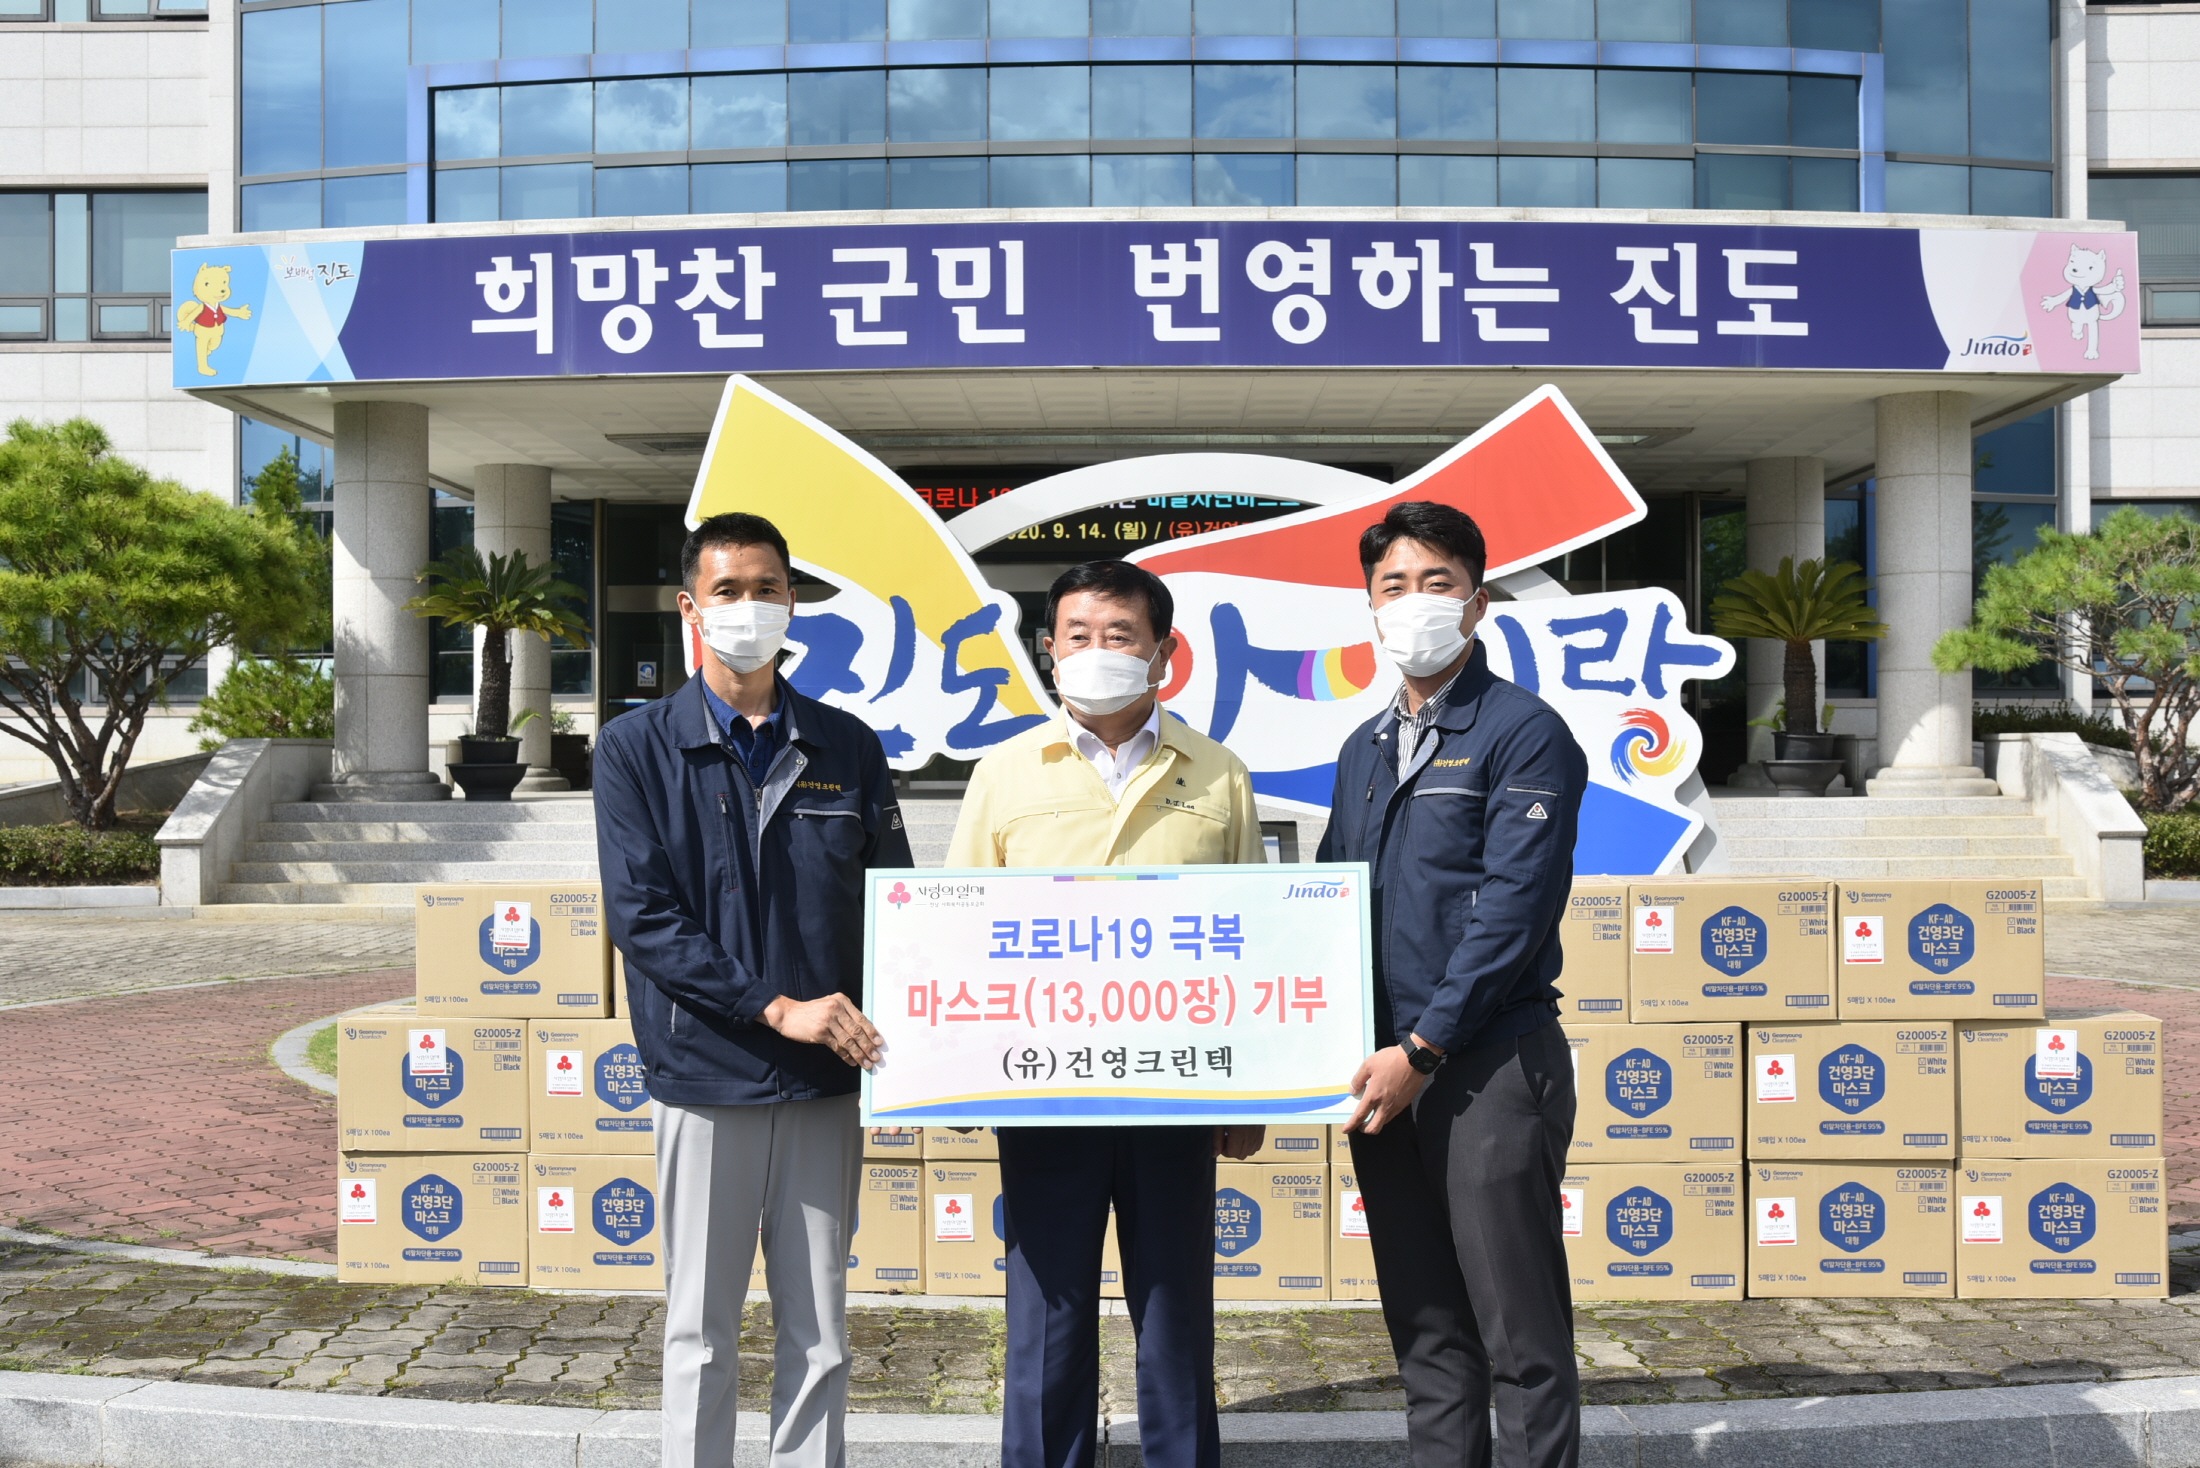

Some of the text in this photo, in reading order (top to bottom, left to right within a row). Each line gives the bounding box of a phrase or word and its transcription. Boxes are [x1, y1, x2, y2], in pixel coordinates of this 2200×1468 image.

[317, 261, 355, 286] 진도
[471, 238, 1809, 356] 희망찬 군민 번영하는 진도
[1960, 337, 2021, 357] Jindo
[1053, 522, 1071, 539] 9.
[1079, 522, 1107, 540] 14.
[1114, 521, 1148, 540] (월)
[915, 883, 954, 900] 사랑의
[1283, 882, 1341, 899] Jindo
[1986, 890, 2036, 899] G20005-Z
[551, 893, 597, 902] G20005-Z
[1778, 891, 1828, 901] G20005-Z
[1722, 916, 1745, 926] KF-AD
[1809, 918, 1828, 926] White
[1929, 914, 1953, 924] KF-AD
[2016, 917, 2036, 925] White
[579, 928, 596, 936] Black
[1809, 927, 1828, 935] Black
[1918, 926, 1964, 941] 건영3단
[2016, 926, 2035, 934] Black
[989, 914, 1245, 962] 코로나19 극복
[1711, 928, 1756, 943] 건영3단
[1715, 945, 1753, 958] 마스크
[1922, 943, 1960, 956] 마스크
[503, 959, 516, 968] 대형
[1727, 961, 1741, 969] 대형
[1934, 958, 1948, 967] 대형
[424, 996, 441, 1004] 5매입
[908, 974, 1328, 1028] 마스크(13,000장) 기부
[1640, 999, 1658, 1007] 5매입
[474, 1028, 521, 1037] G20005-Z
[1897, 1031, 1947, 1040] G20005-Z
[2104, 1031, 2155, 1040] G20005-Z
[1683, 1035, 1734, 1045] G20005-Z
[614, 1053, 636, 1063] KF-AD
[1002, 1045, 1233, 1080] (유)건영크린텍
[1840, 1054, 1864, 1064] KF-AD
[1927, 1057, 1947, 1065] White
[2135, 1058, 2155, 1066] White
[503, 1063, 520, 1071] Black
[1626, 1058, 1651, 1068] KF-AD
[1713, 1061, 1733, 1069] White
[1829, 1066, 1875, 1081] 건영3단
[1927, 1066, 1945, 1074] Black
[1615, 1070, 1662, 1085] 건영3단
[415, 1078, 451, 1091] 마스크
[607, 1081, 643, 1094] 마스크
[1619, 1087, 1658, 1100] 마스크
[1833, 1083, 1870, 1096] 마스크
[2039, 1083, 2078, 1096] 마스크
[426, 1093, 439, 1101] 대형
[619, 1096, 632, 1105] 대형
[1632, 1102, 1645, 1111] 대형
[1845, 1098, 1858, 1107] 대형
[2051, 1099, 2066, 1107] 대형
[1757, 1136, 1776, 1144] 5매입
[473, 1162, 519, 1171] G20005-Z
[1684, 1173, 1734, 1182] G20005-Z
[1897, 1169, 1947, 1178] G20005-Z
[2108, 1169, 2158, 1179] G20005-Z
[421, 1184, 443, 1193] KF-AD
[612, 1187, 634, 1197] KF-AD
[501, 1197, 519, 1205] Black
[1627, 1196, 1651, 1206] KF-AD
[1840, 1192, 1864, 1202] KF-AD
[1927, 1196, 1947, 1204] White
[2050, 1193, 2074, 1203] KF-AD
[2139, 1196, 2158, 1204] White
[411, 1196, 453, 1210] 건영3단
[602, 1199, 645, 1213] 건영3단
[1714, 1199, 1734, 1207] White
[1714, 1208, 1733, 1216] Black
[1829, 1204, 1875, 1219] 건영3단
[1927, 1205, 1946, 1213] Black
[2039, 1205, 2084, 1219] 건영3단
[2139, 1205, 2157, 1213] Black
[415, 1211, 450, 1224] 마스크
[1616, 1208, 1662, 1223] 건영3단
[605, 1215, 641, 1228] 마스크
[426, 1226, 439, 1234] 대형
[1620, 1225, 1658, 1238] 마스크
[1833, 1221, 1871, 1234] 마스크
[2043, 1222, 2081, 1235] 마스크
[617, 1230, 630, 1238] 대형
[1633, 1240, 1646, 1249] 대형
[1845, 1236, 1859, 1245] 대형
[2055, 1238, 2069, 1246] 대형
